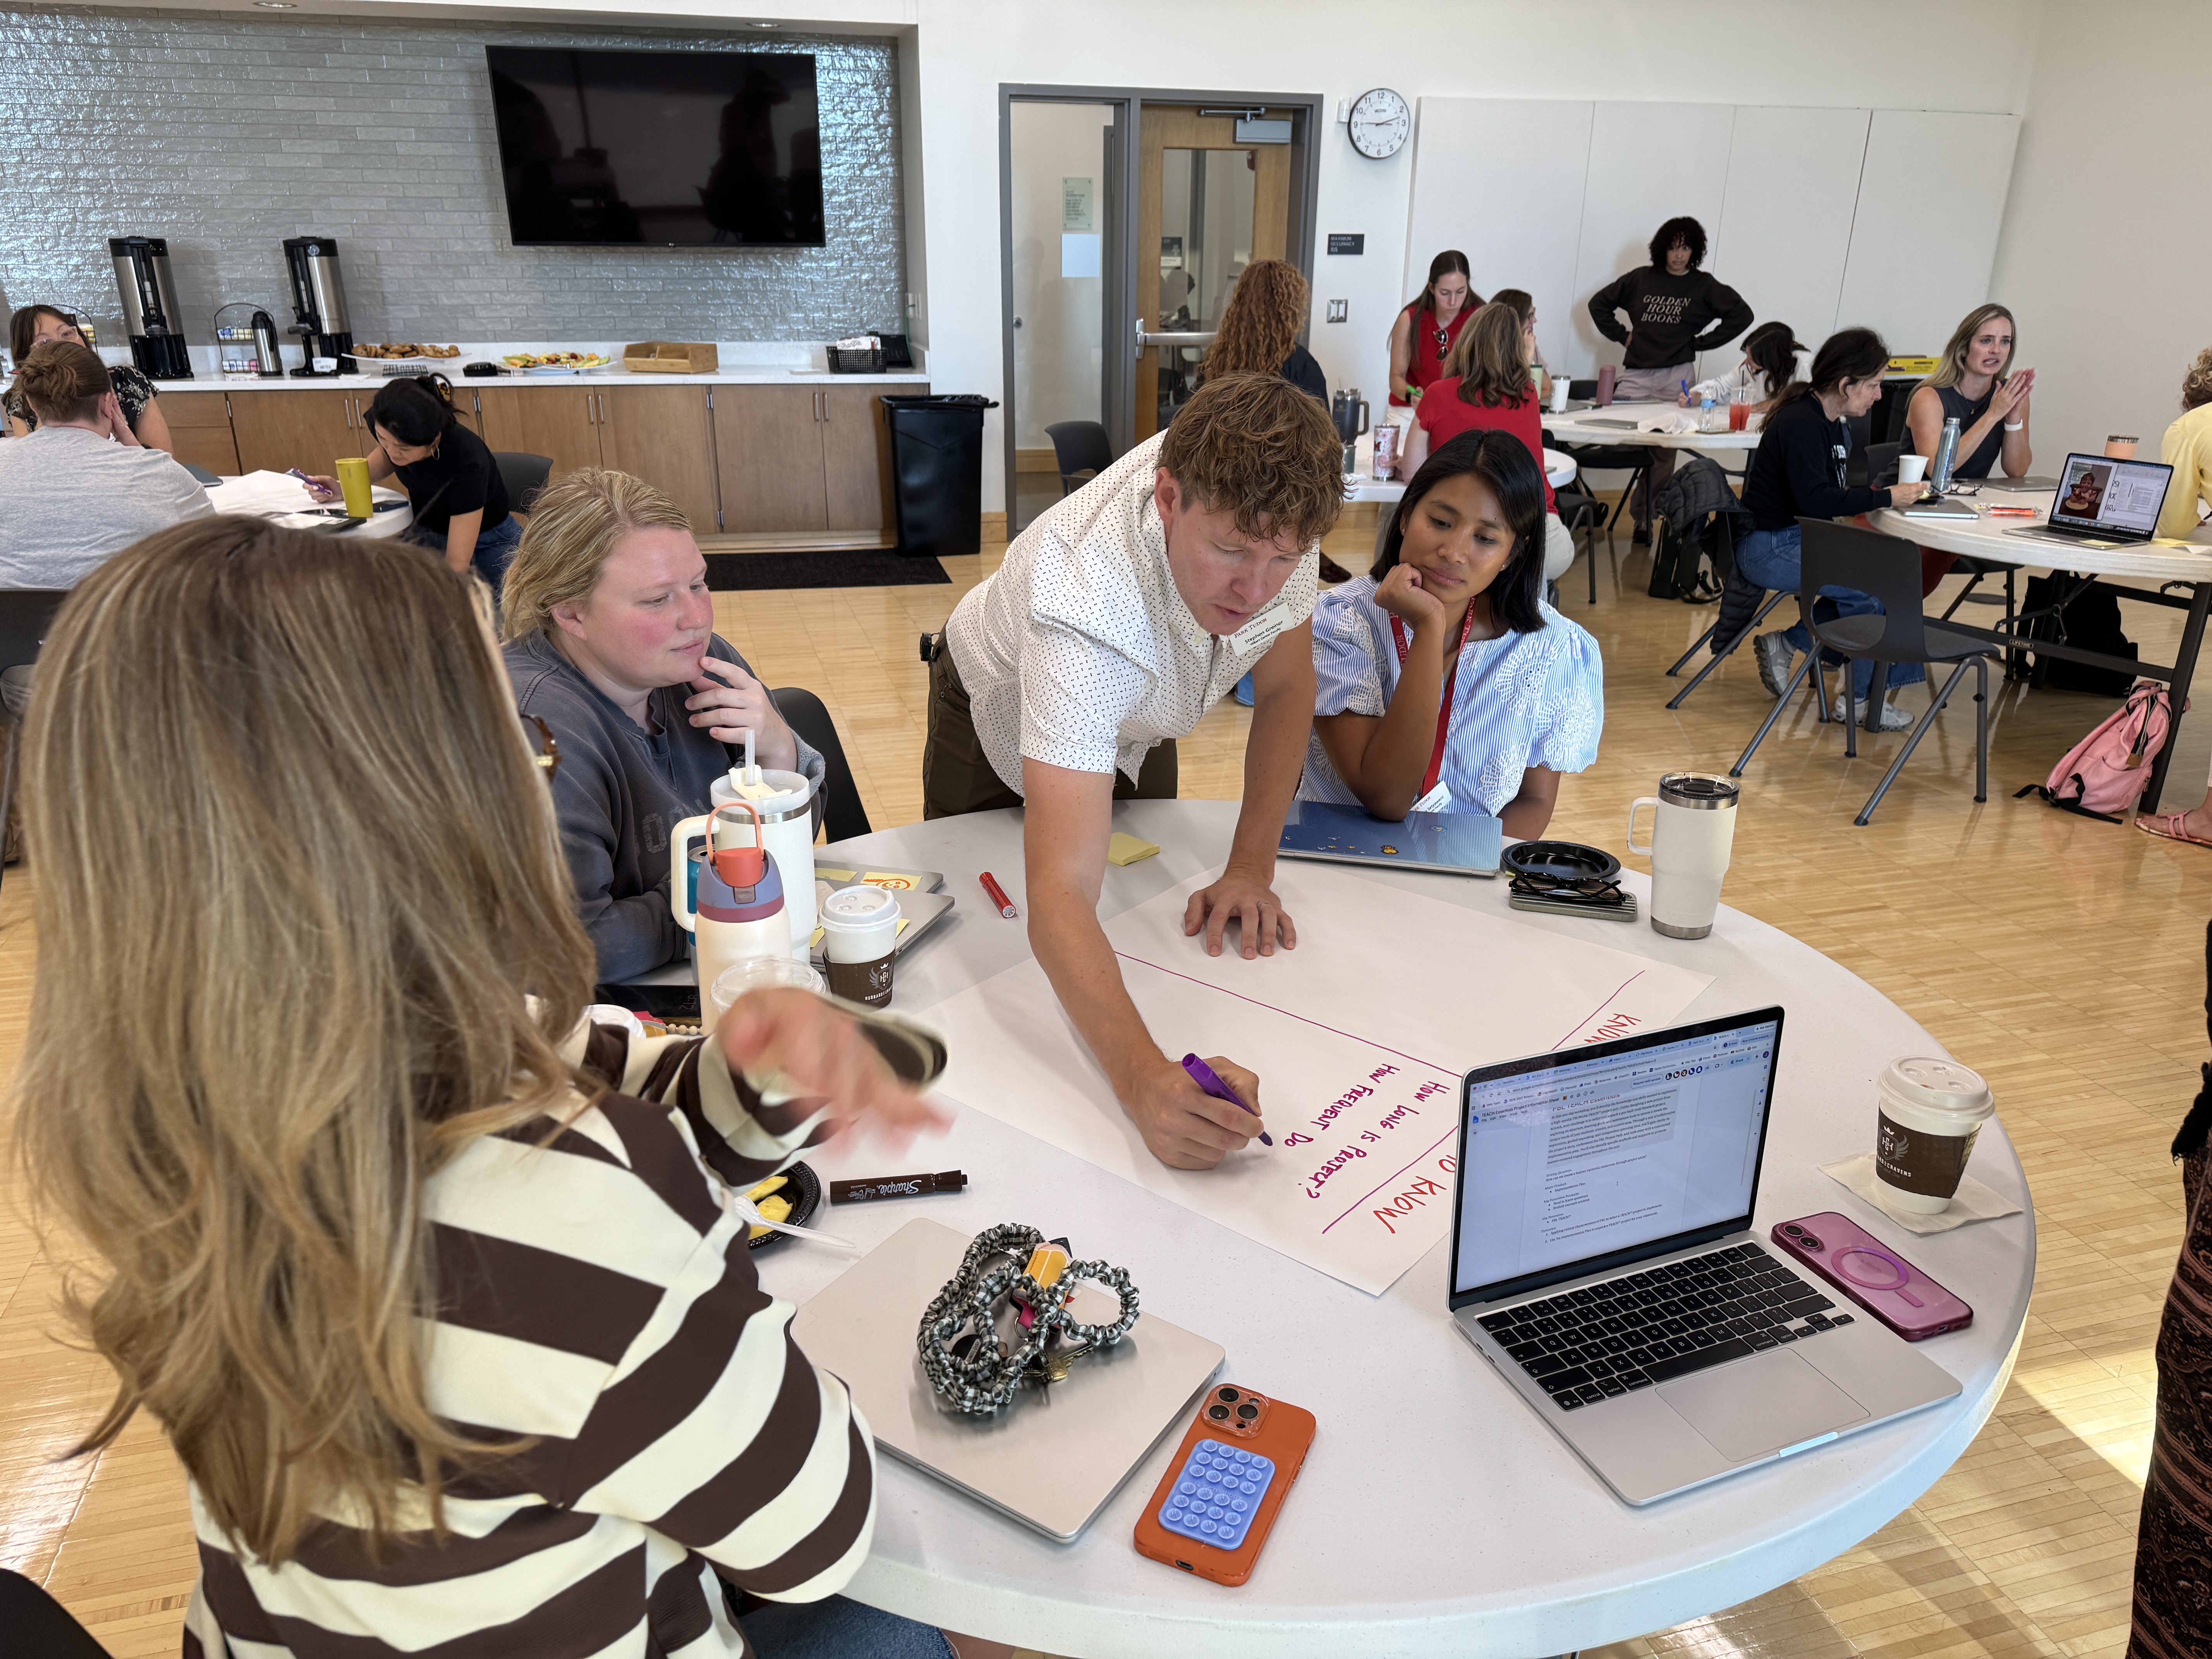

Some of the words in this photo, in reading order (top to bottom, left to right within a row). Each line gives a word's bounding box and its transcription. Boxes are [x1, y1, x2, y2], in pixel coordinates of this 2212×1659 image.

[1643, 294, 1692, 307] GOLDEN
[1647, 304, 1681, 315] HOUR
[1641, 313, 1681, 324] BOOKS
[1234, 628, 1248, 638] PARK
[1249, 618, 1267, 630] TUDOR
[1397, 635, 1407, 662] UDOR
[1419, 796, 1431, 807] TUDOR
[878, 1180, 922, 1196] Sharpie
[1373, 1176, 1447, 1234] KNOW
[1755, 1339, 1774, 1347] command
[1628, 1377, 1649, 1386] command
